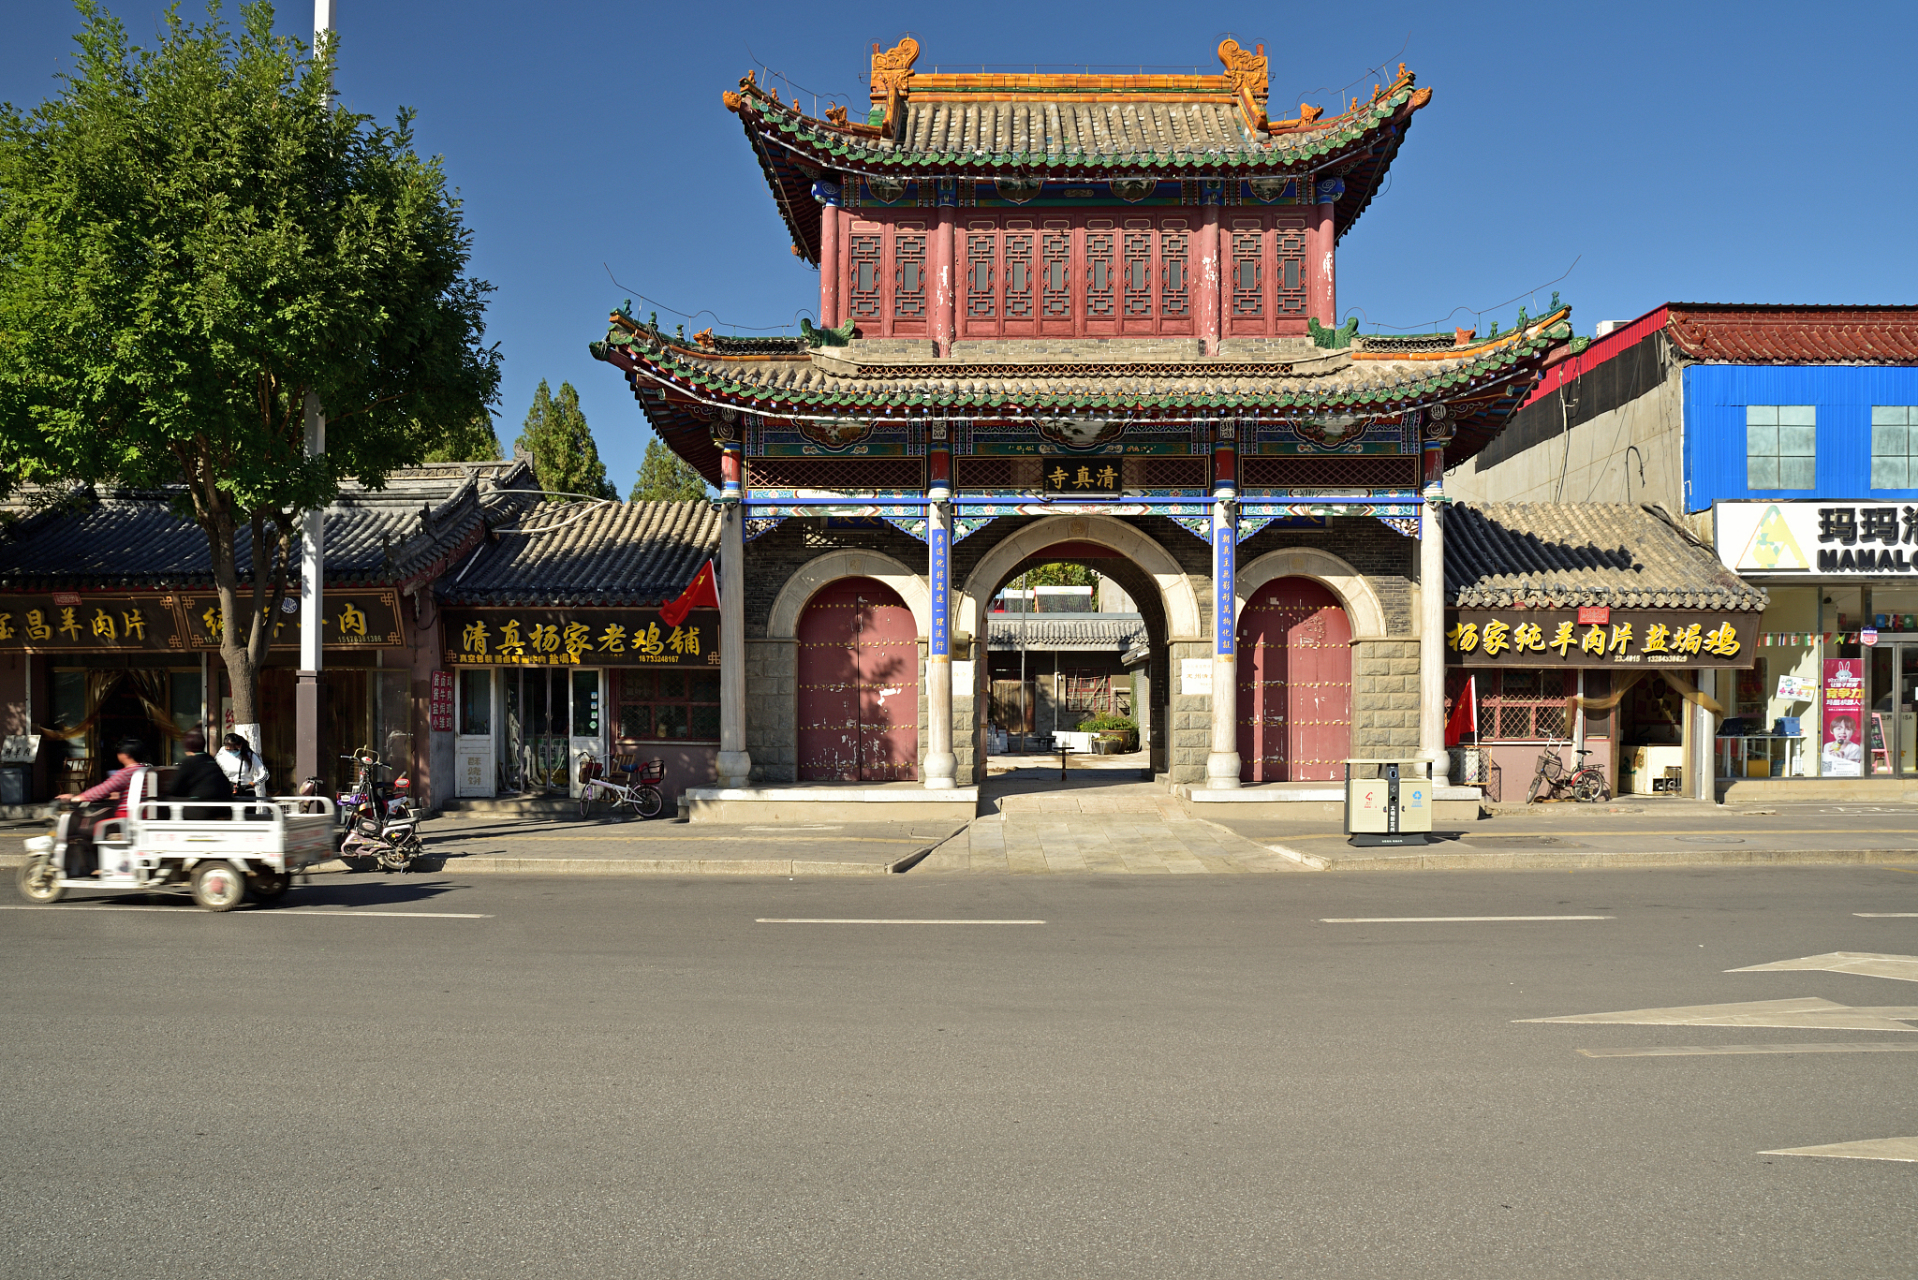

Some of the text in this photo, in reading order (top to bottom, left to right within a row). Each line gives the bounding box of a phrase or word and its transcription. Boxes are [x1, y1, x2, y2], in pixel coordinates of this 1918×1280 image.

[1047, 464, 1119, 490] 清真寺
[1446, 618, 1741, 657] 杨家纯羊肉片 盐焗鸡
